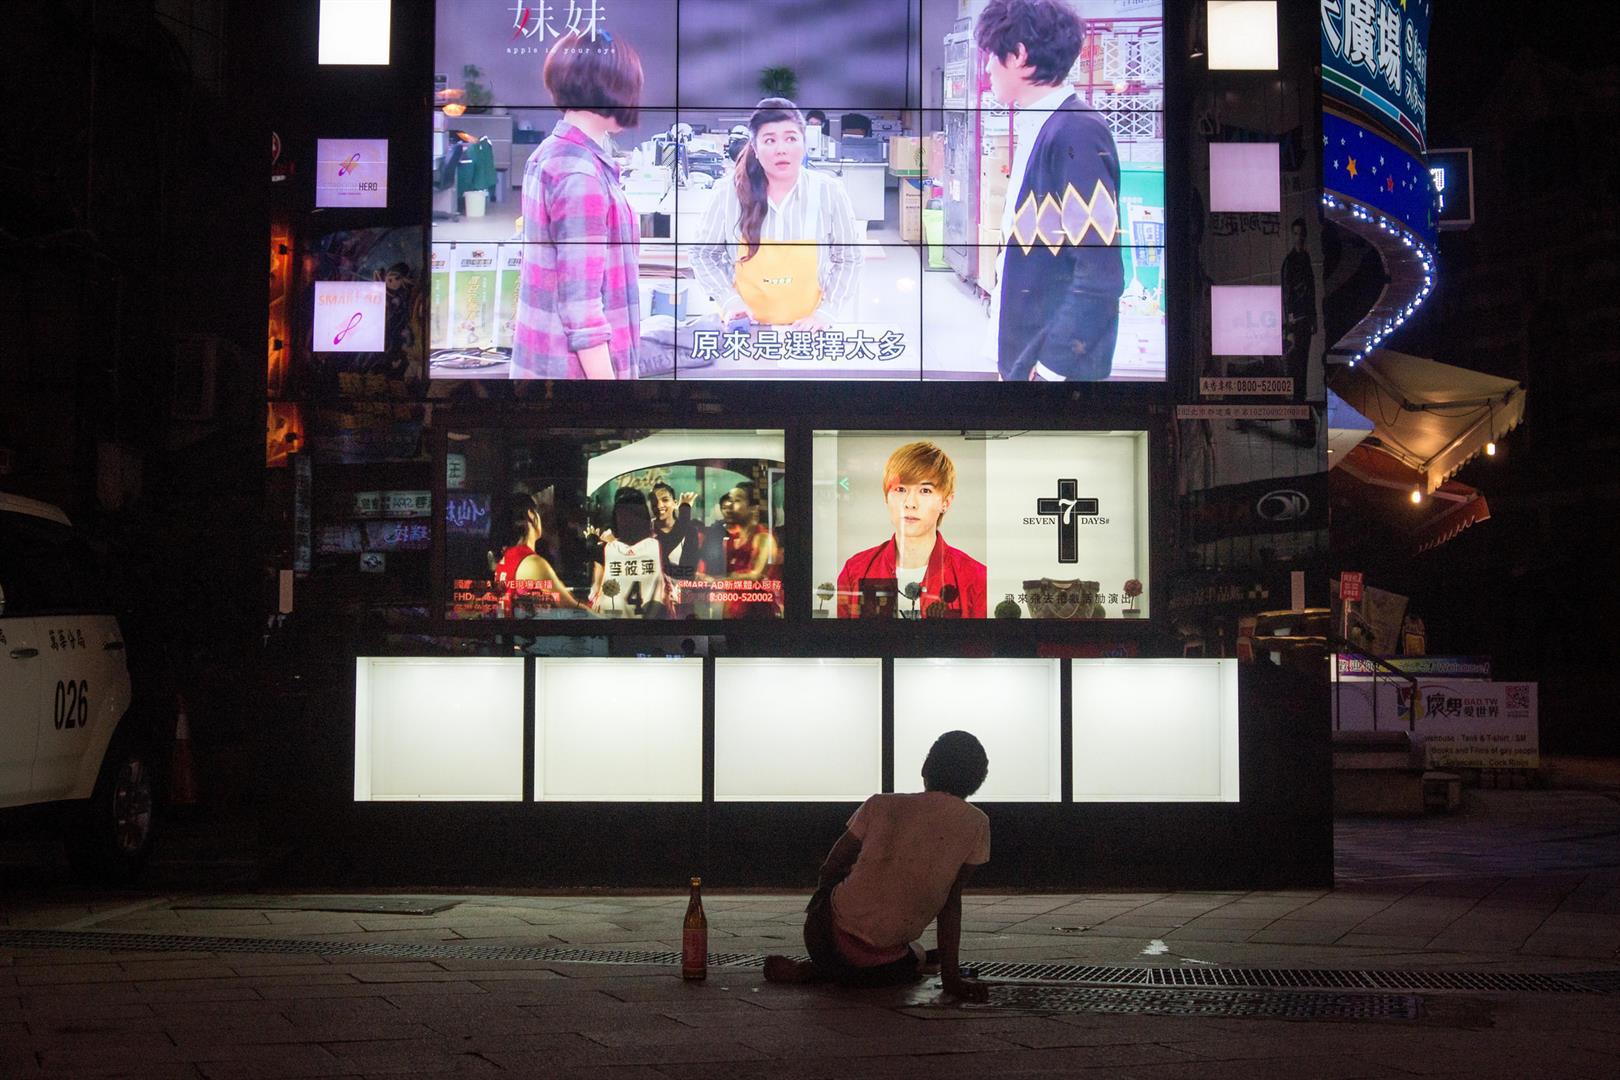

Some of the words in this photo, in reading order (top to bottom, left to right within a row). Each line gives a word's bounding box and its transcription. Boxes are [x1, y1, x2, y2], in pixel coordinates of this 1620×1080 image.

[507, 0, 606, 42] 妹妹
[358, 182, 378, 191] HERO
[1247, 311, 1277, 328] LG
[691, 330, 906, 361] 原來是選擇太多
[1022, 517, 1056, 525] SEVEN
[1058, 498, 1078, 525] 7
[54, 679, 89, 729] 026
